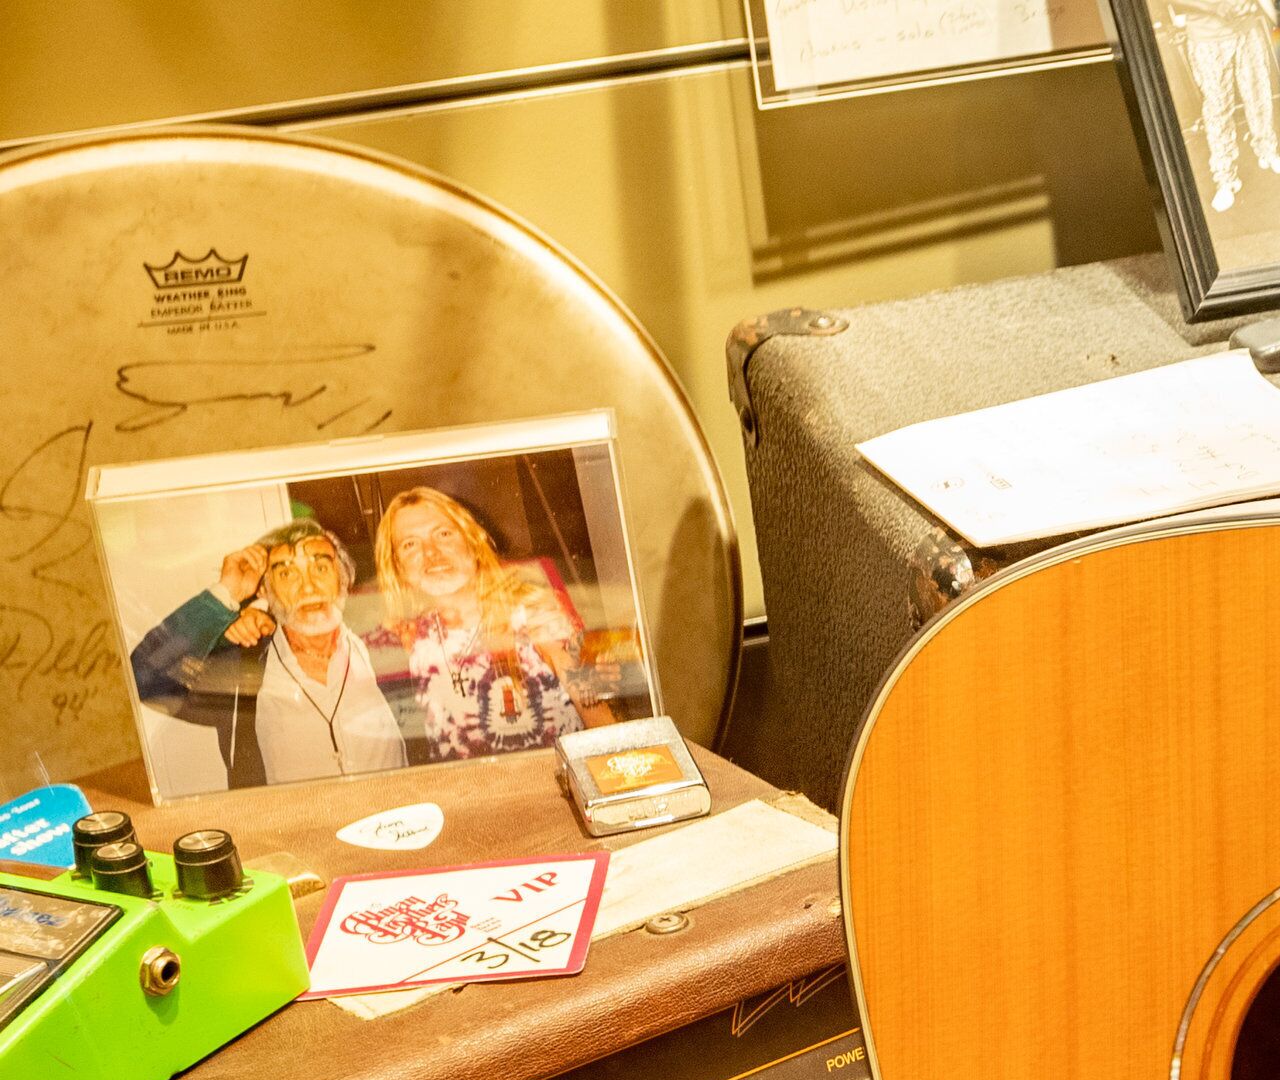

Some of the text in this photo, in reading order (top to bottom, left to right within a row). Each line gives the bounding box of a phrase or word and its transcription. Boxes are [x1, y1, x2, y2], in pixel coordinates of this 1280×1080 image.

[163, 265, 232, 284] REMO
[153, 289, 210, 304] WEATHER
[150, 303, 203, 319] EMPEROR
[490, 870, 561, 904] VIP
[460, 928, 572, 970] 3/18
